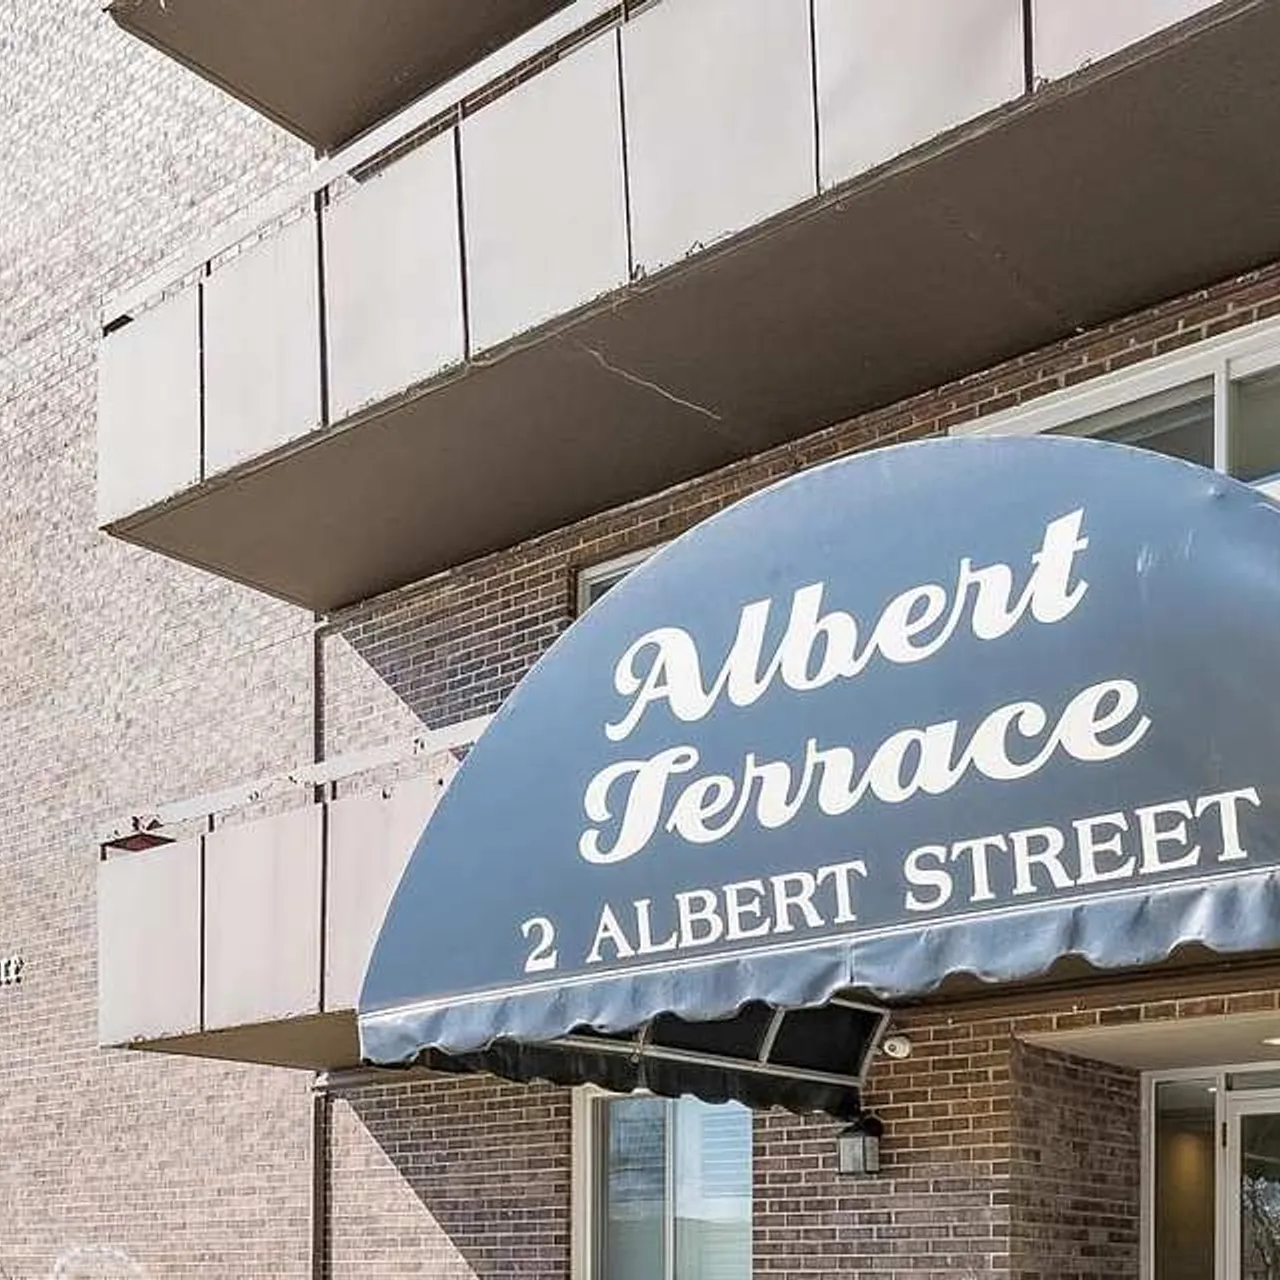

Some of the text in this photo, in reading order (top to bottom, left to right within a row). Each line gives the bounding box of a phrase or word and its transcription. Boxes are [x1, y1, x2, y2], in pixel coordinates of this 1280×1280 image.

[605, 508, 1088, 742] Albert
[579, 677, 1152, 864] Terrace
[523, 787, 1261, 973] 2 ALBERT STREET
